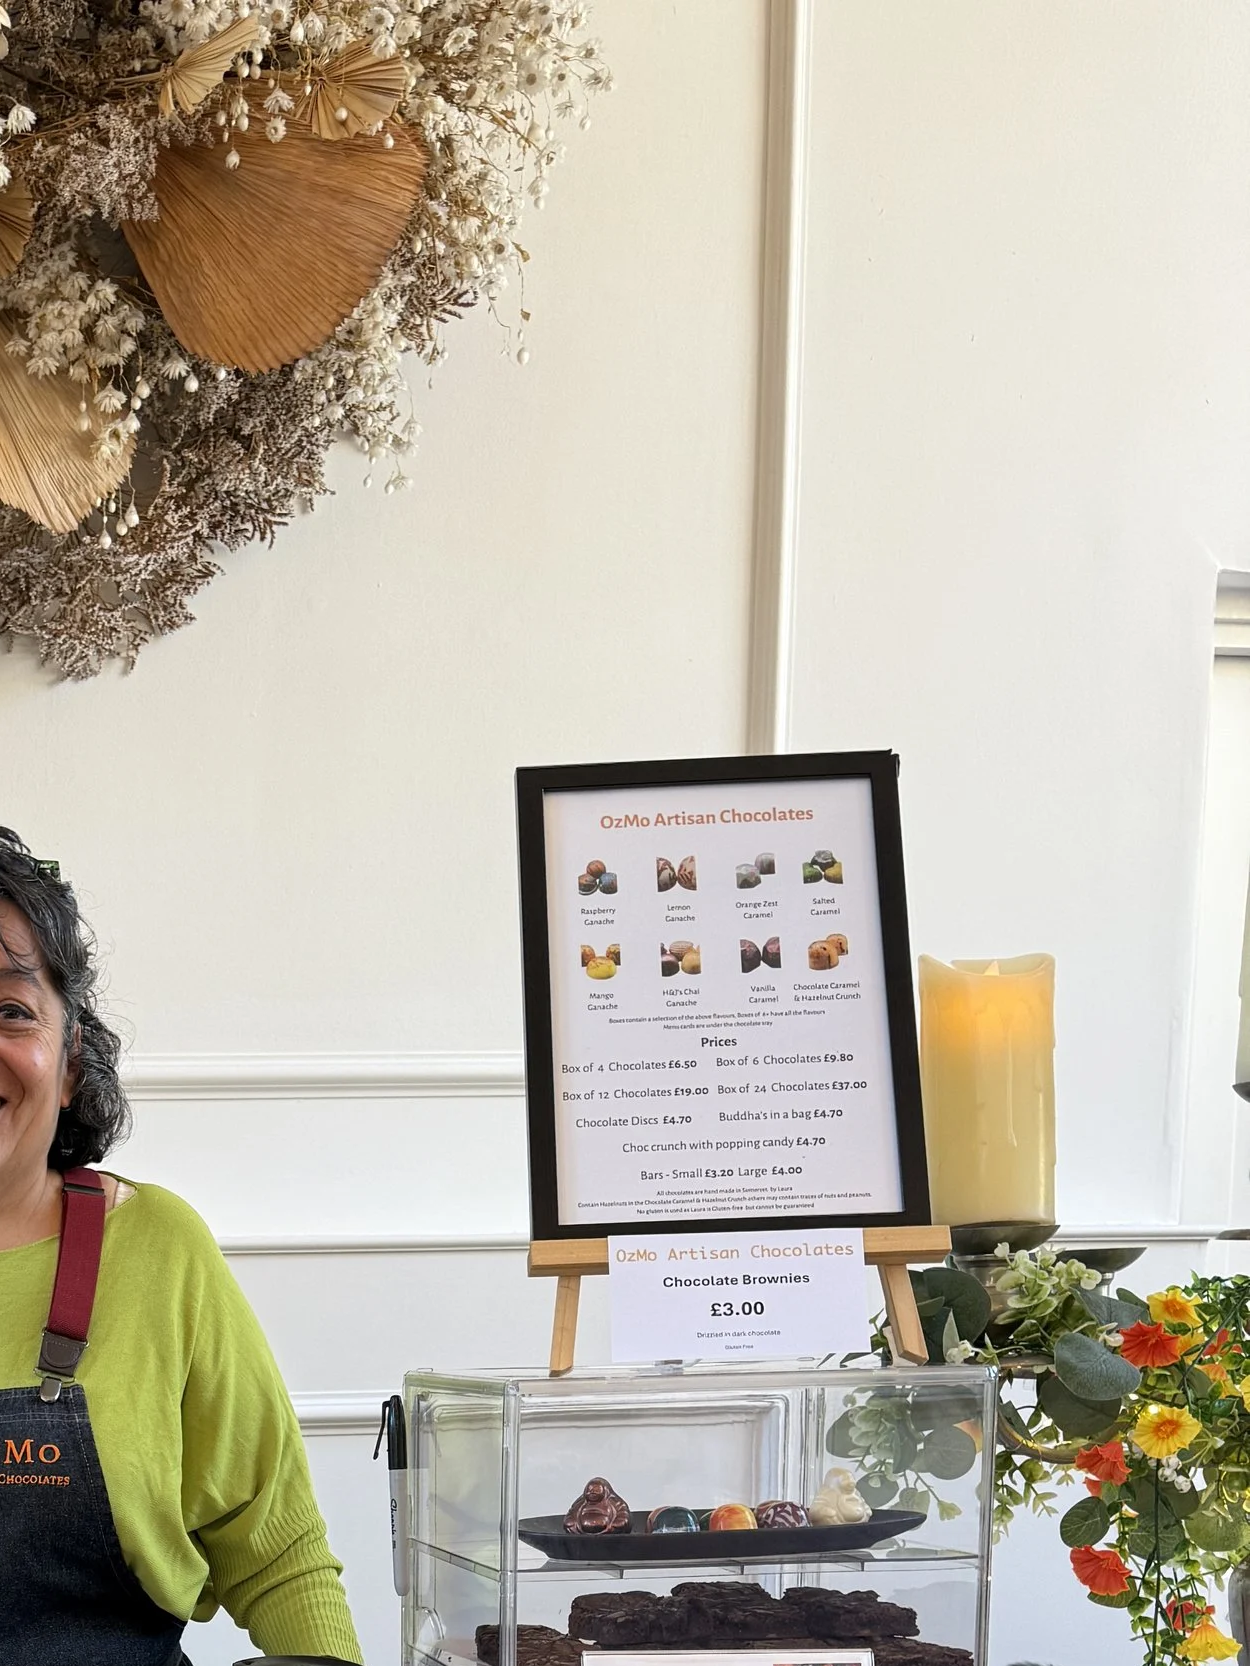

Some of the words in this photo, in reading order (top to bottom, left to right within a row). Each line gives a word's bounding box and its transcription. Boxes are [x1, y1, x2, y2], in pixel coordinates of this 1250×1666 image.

[600, 814, 650, 828] OzMo
[654, 811, 716, 826] Artisan
[720, 807, 813, 823] Chocolates
[744, 911, 773, 919] Caramel
[584, 918, 614, 926] Ganache
[830, 981, 860, 989] Caramel
[836, 992, 861, 1000] Crunch
[701, 1036, 737, 1047] Prices
[716, 1058, 735, 1066] Box
[738, 1056, 748, 1066] of
[753, 1057, 759, 1065] 6
[764, 1054, 821, 1064] Chocolates
[824, 1053, 853, 1063] £9.80
[562, 1064, 580, 1074] Box
[583, 1062, 594, 1072] of
[598, 1064, 604, 1072] 4
[609, 1060, 666, 1071] Chocolates
[668, 1060, 697, 1069] £6.50
[718, 1085, 736, 1094] Box
[739, 1083, 750, 1093] of
[754, 1085, 766, 1093] 24
[771, 1081, 830, 1092] Chocolates
[832, 1081, 867, 1090] £37.00
[563, 1092, 581, 1101] Box
[584, 1090, 595, 1100] of
[614, 1088, 672, 1098] Chocolates
[674, 1088, 709, 1096] £19.00
[719, 1111, 767, 1121] Buddha's
[770, 1110, 780, 1119] in
[792, 1109, 811, 1120] bag
[814, 1109, 843, 1118] £4.70
[576, 1117, 628, 1128] Chocolate
[632, 1116, 658, 1126] Discs
[663, 1116, 692, 1125] £4.70
[622, 1143, 649, 1152] Choc
[651, 1141, 686, 1151] crunch
[689, 1140, 713, 1150] with
[716, 1138, 760, 1150] popping
[763, 1136, 794, 1148] candy
[796, 1137, 825, 1146] £4.70
[641, 1171, 663, 1180] Bars
[672, 1168, 702, 1179] Small
[705, 1169, 734, 1178] £3.20
[738, 1168, 767, 1178] Large
[772, 1166, 802, 1176] £4.00
[616, 1249, 657, 1262] OzMo
[668, 1246, 739, 1260] Artisan
[751, 1243, 854, 1258] Chocolates
[663, 1276, 738, 1287] Chocolate
[743, 1273, 810, 1285] Brownies
[710, 1302, 764, 1316] £3.00
